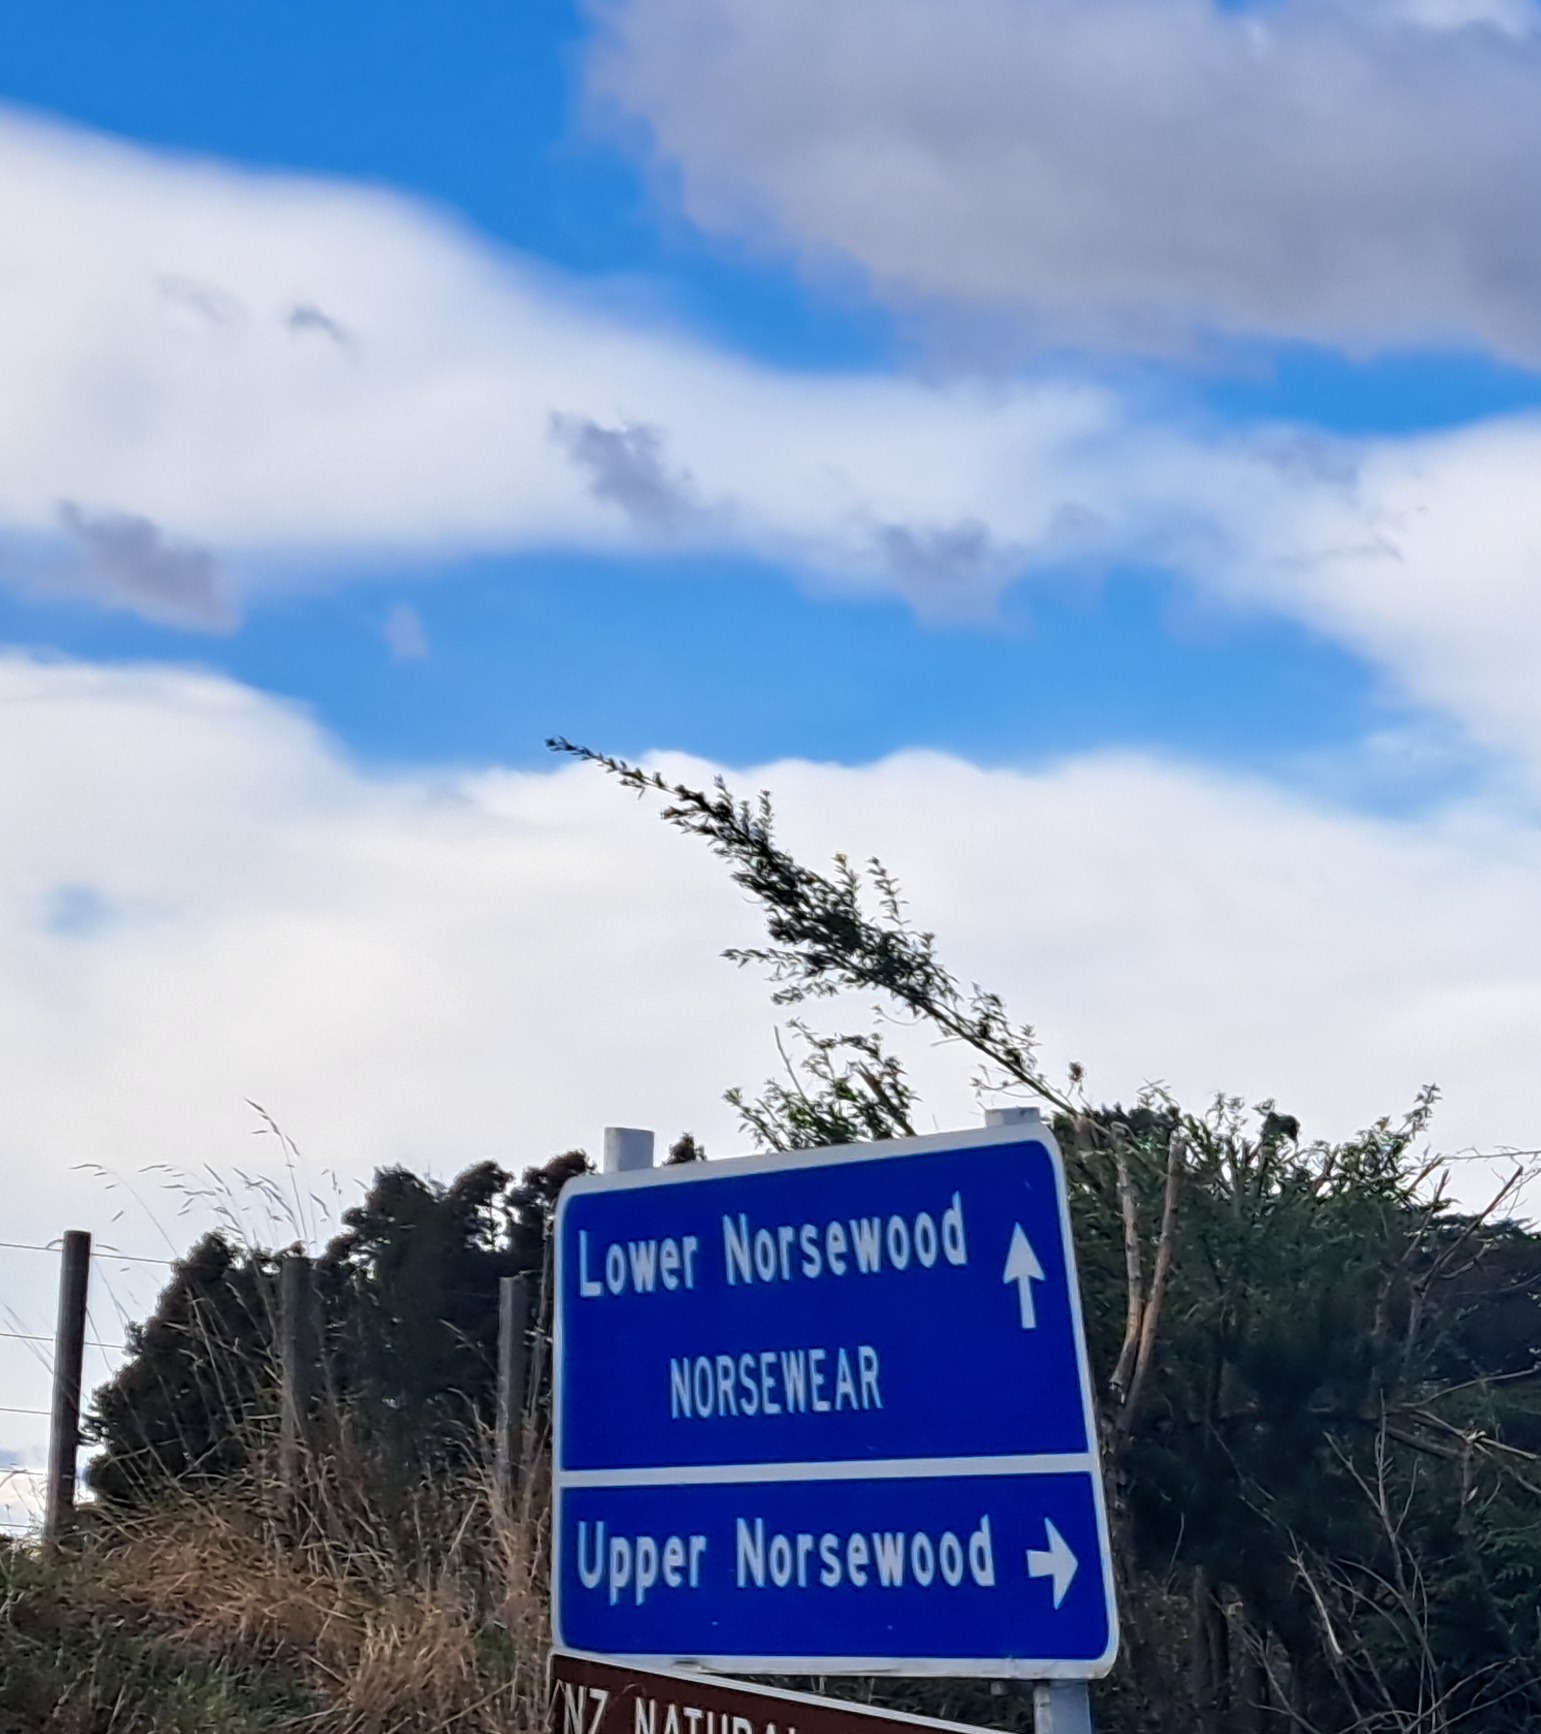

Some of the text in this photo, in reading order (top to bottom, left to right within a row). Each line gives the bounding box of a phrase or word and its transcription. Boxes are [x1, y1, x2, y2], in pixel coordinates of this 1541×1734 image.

[578, 1192, 969, 1300] Lower Norsewood
[669, 1345, 884, 1420] NORSEWEAR
[576, 1514, 996, 1606] Upper Norsewood
